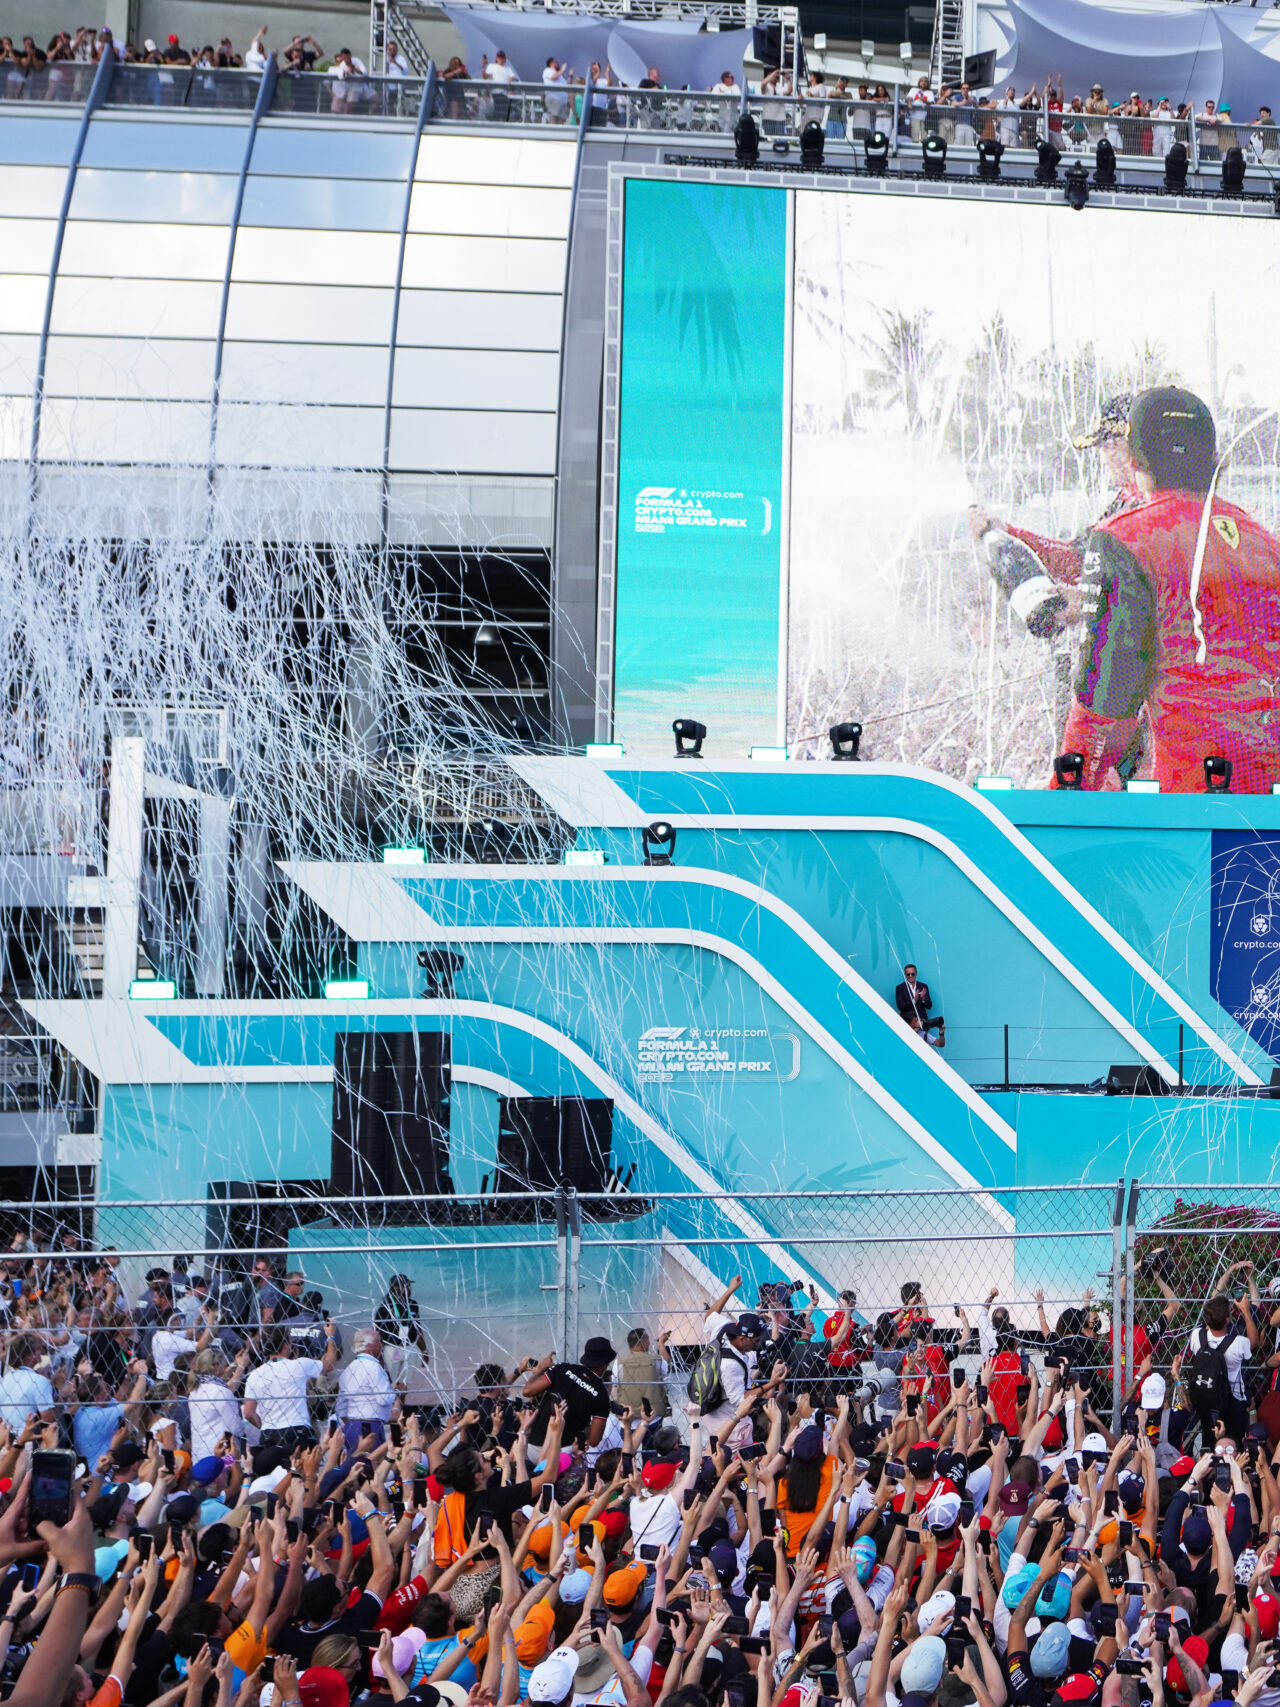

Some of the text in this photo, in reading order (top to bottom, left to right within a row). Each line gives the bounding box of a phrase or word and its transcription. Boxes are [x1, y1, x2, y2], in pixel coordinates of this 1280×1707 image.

[691, 490, 744, 499] crypto.com
[636, 498, 703, 508] FORMULA 1
[636, 507, 712, 517] CRYPTO.COM
[635, 516, 747, 527] MIAMI GRAND PRIX
[704, 1028, 767, 1038] crypto.com
[638, 1041, 718, 1050] FORMULA 1
[638, 1051, 729, 1061] CRYPTO.COM
[638, 1062, 771, 1072] MIAMI GRAND PRIX
[639, 1073, 673, 1082] 2022
[565, 1370, 598, 1396] PETRONAS
